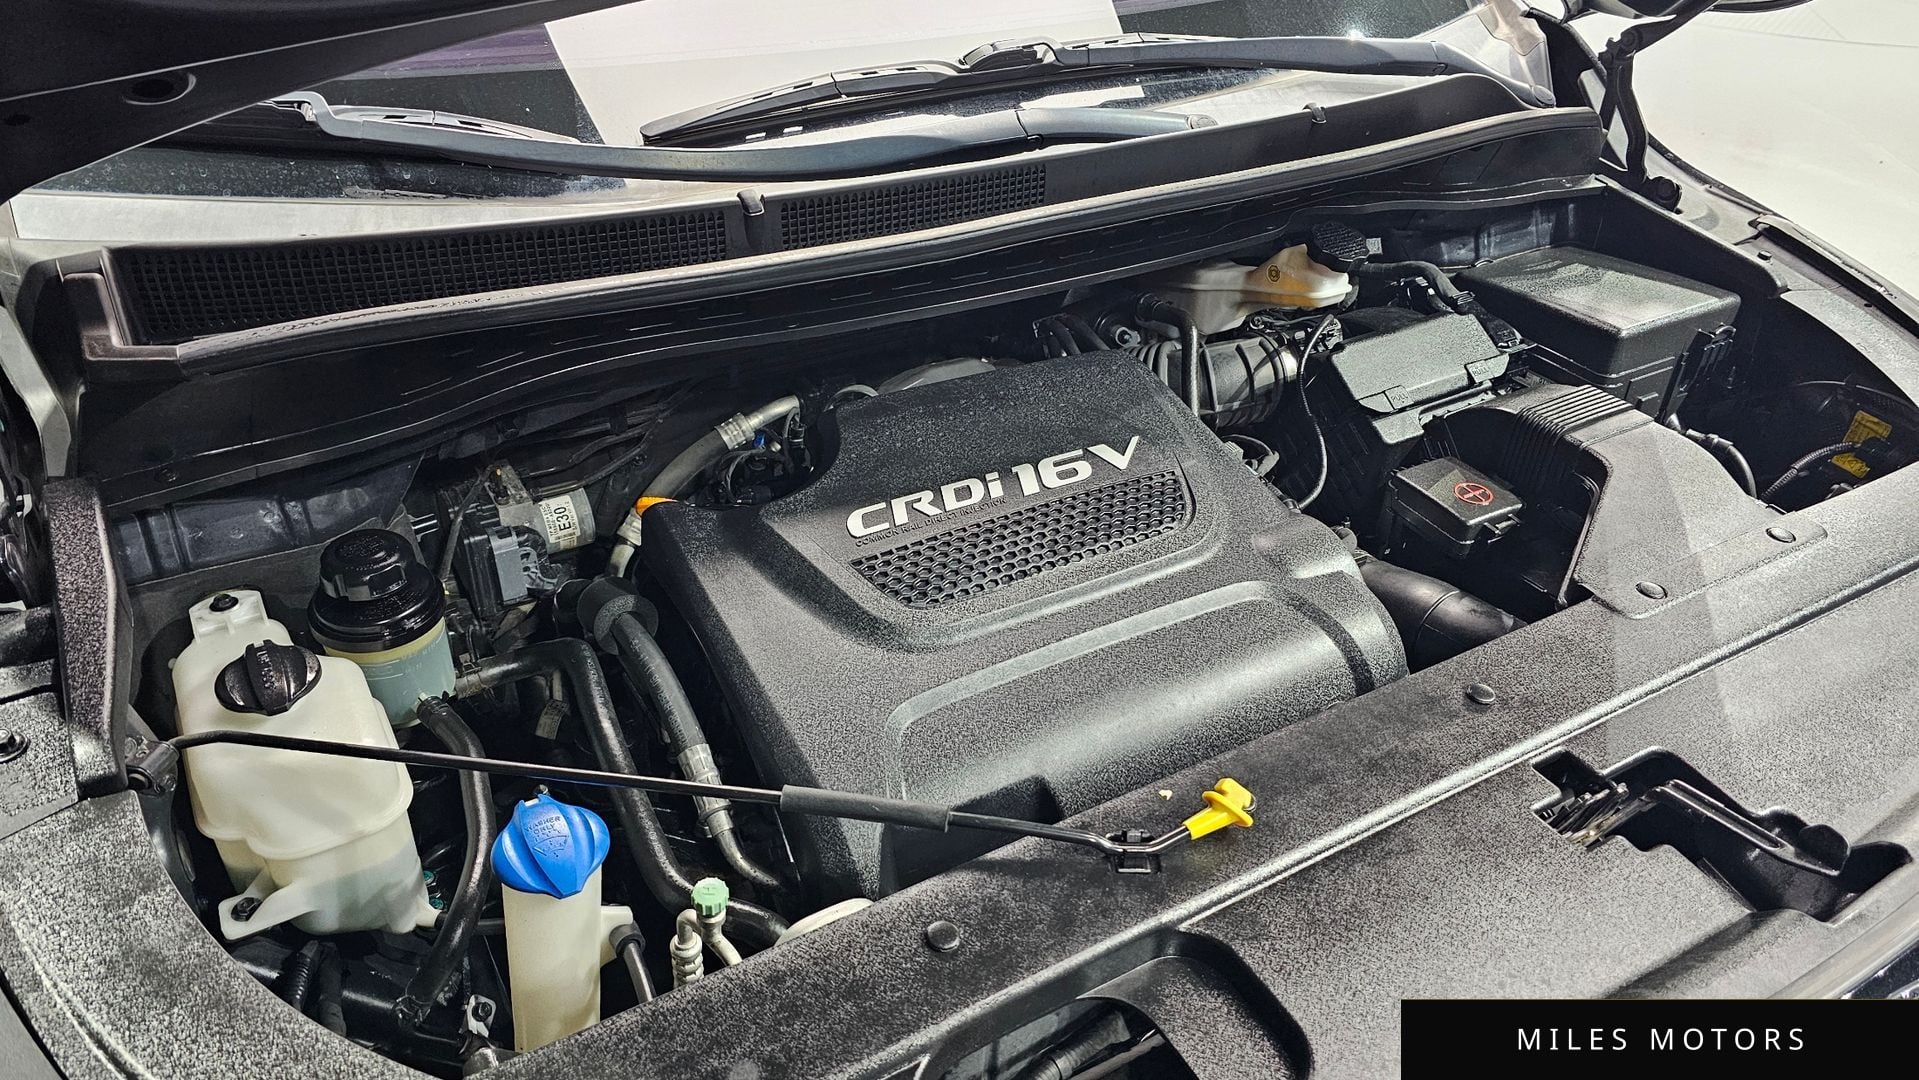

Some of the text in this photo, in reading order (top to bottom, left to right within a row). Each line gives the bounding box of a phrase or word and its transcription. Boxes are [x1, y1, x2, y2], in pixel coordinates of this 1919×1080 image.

[846, 436, 1140, 538] CRDi 16V
[554, 506, 572, 531] E30
[855, 498, 1007, 547] COMMON RAIL DIRECT INJECTION
[524, 815, 561, 832] WASHER
[533, 823, 556, 835] ONLY
